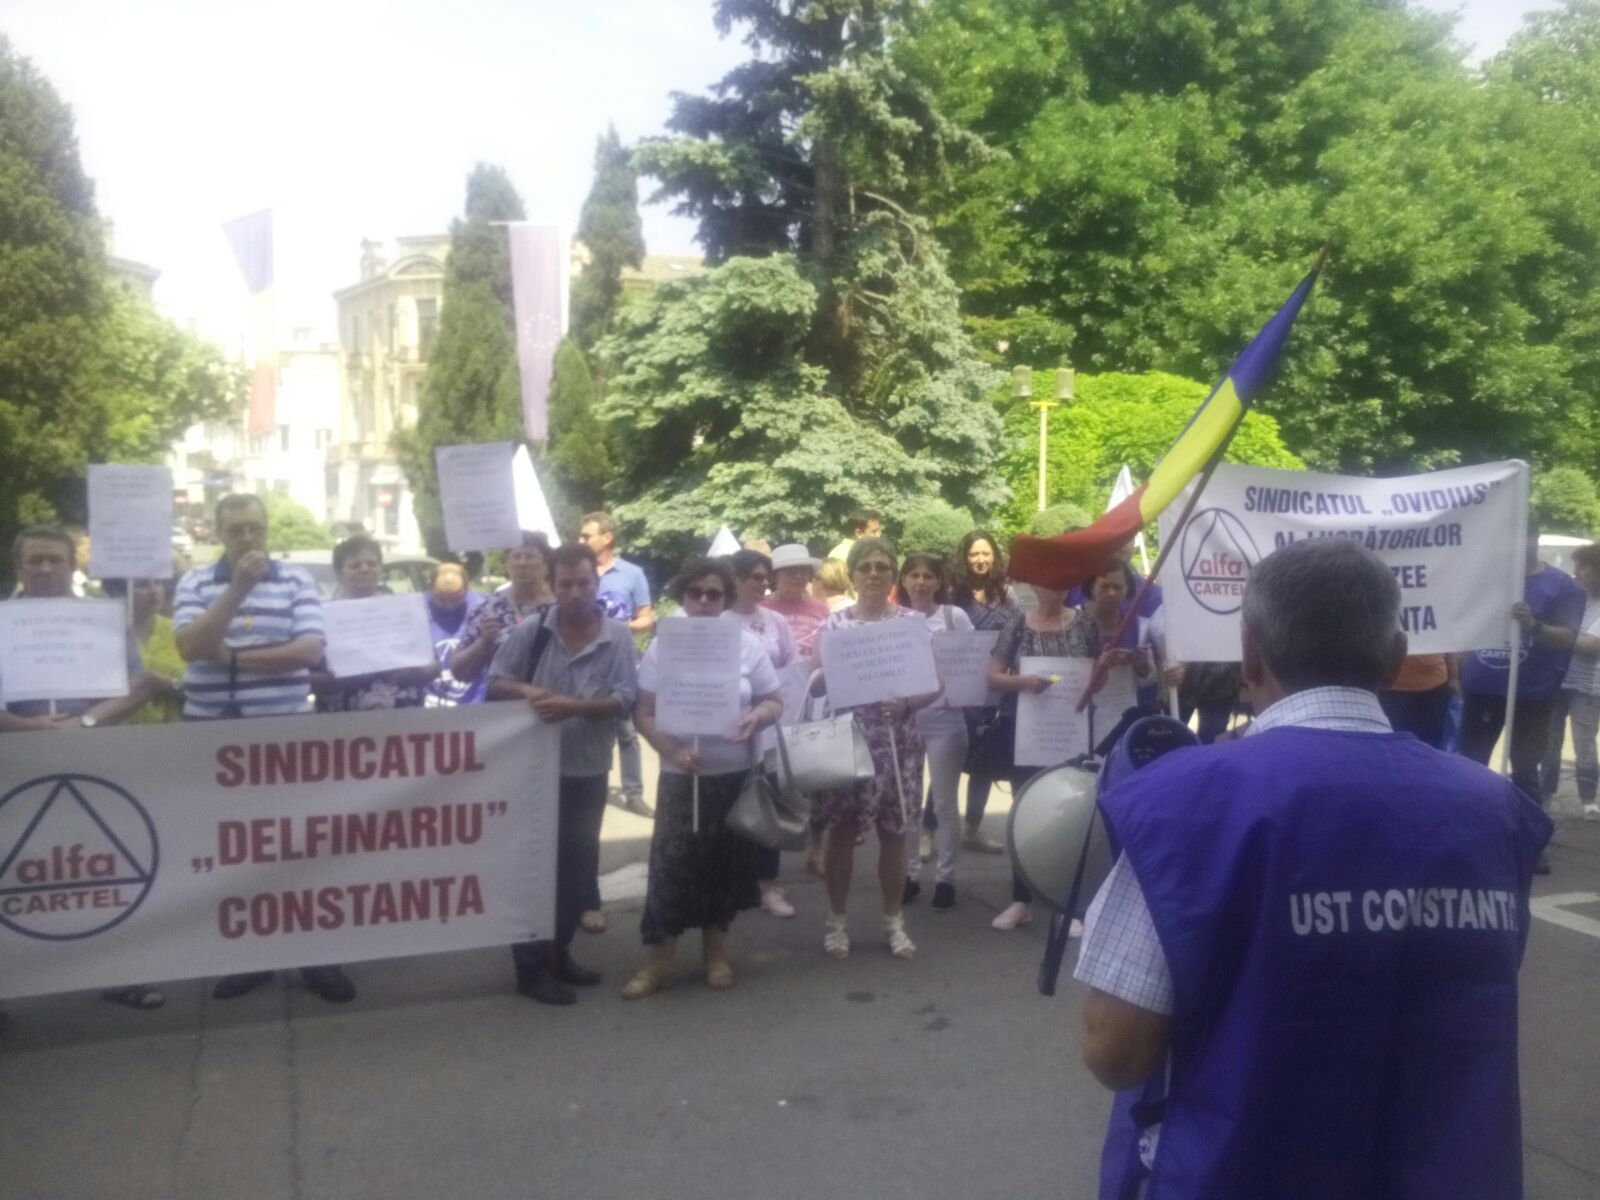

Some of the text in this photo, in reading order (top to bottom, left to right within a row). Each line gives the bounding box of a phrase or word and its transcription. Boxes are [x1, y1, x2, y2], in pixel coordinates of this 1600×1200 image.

[1244, 485, 1372, 515] SINDICATUL
[1200, 552, 1243, 576] alfa
[215, 731, 485, 787] SINDICATUL
[16, 843, 117, 884] alfa
[2, 888, 130, 916] CARTEL
[217, 874, 485, 939] CONSTANȚA
[1290, 891, 1351, 936] UST
